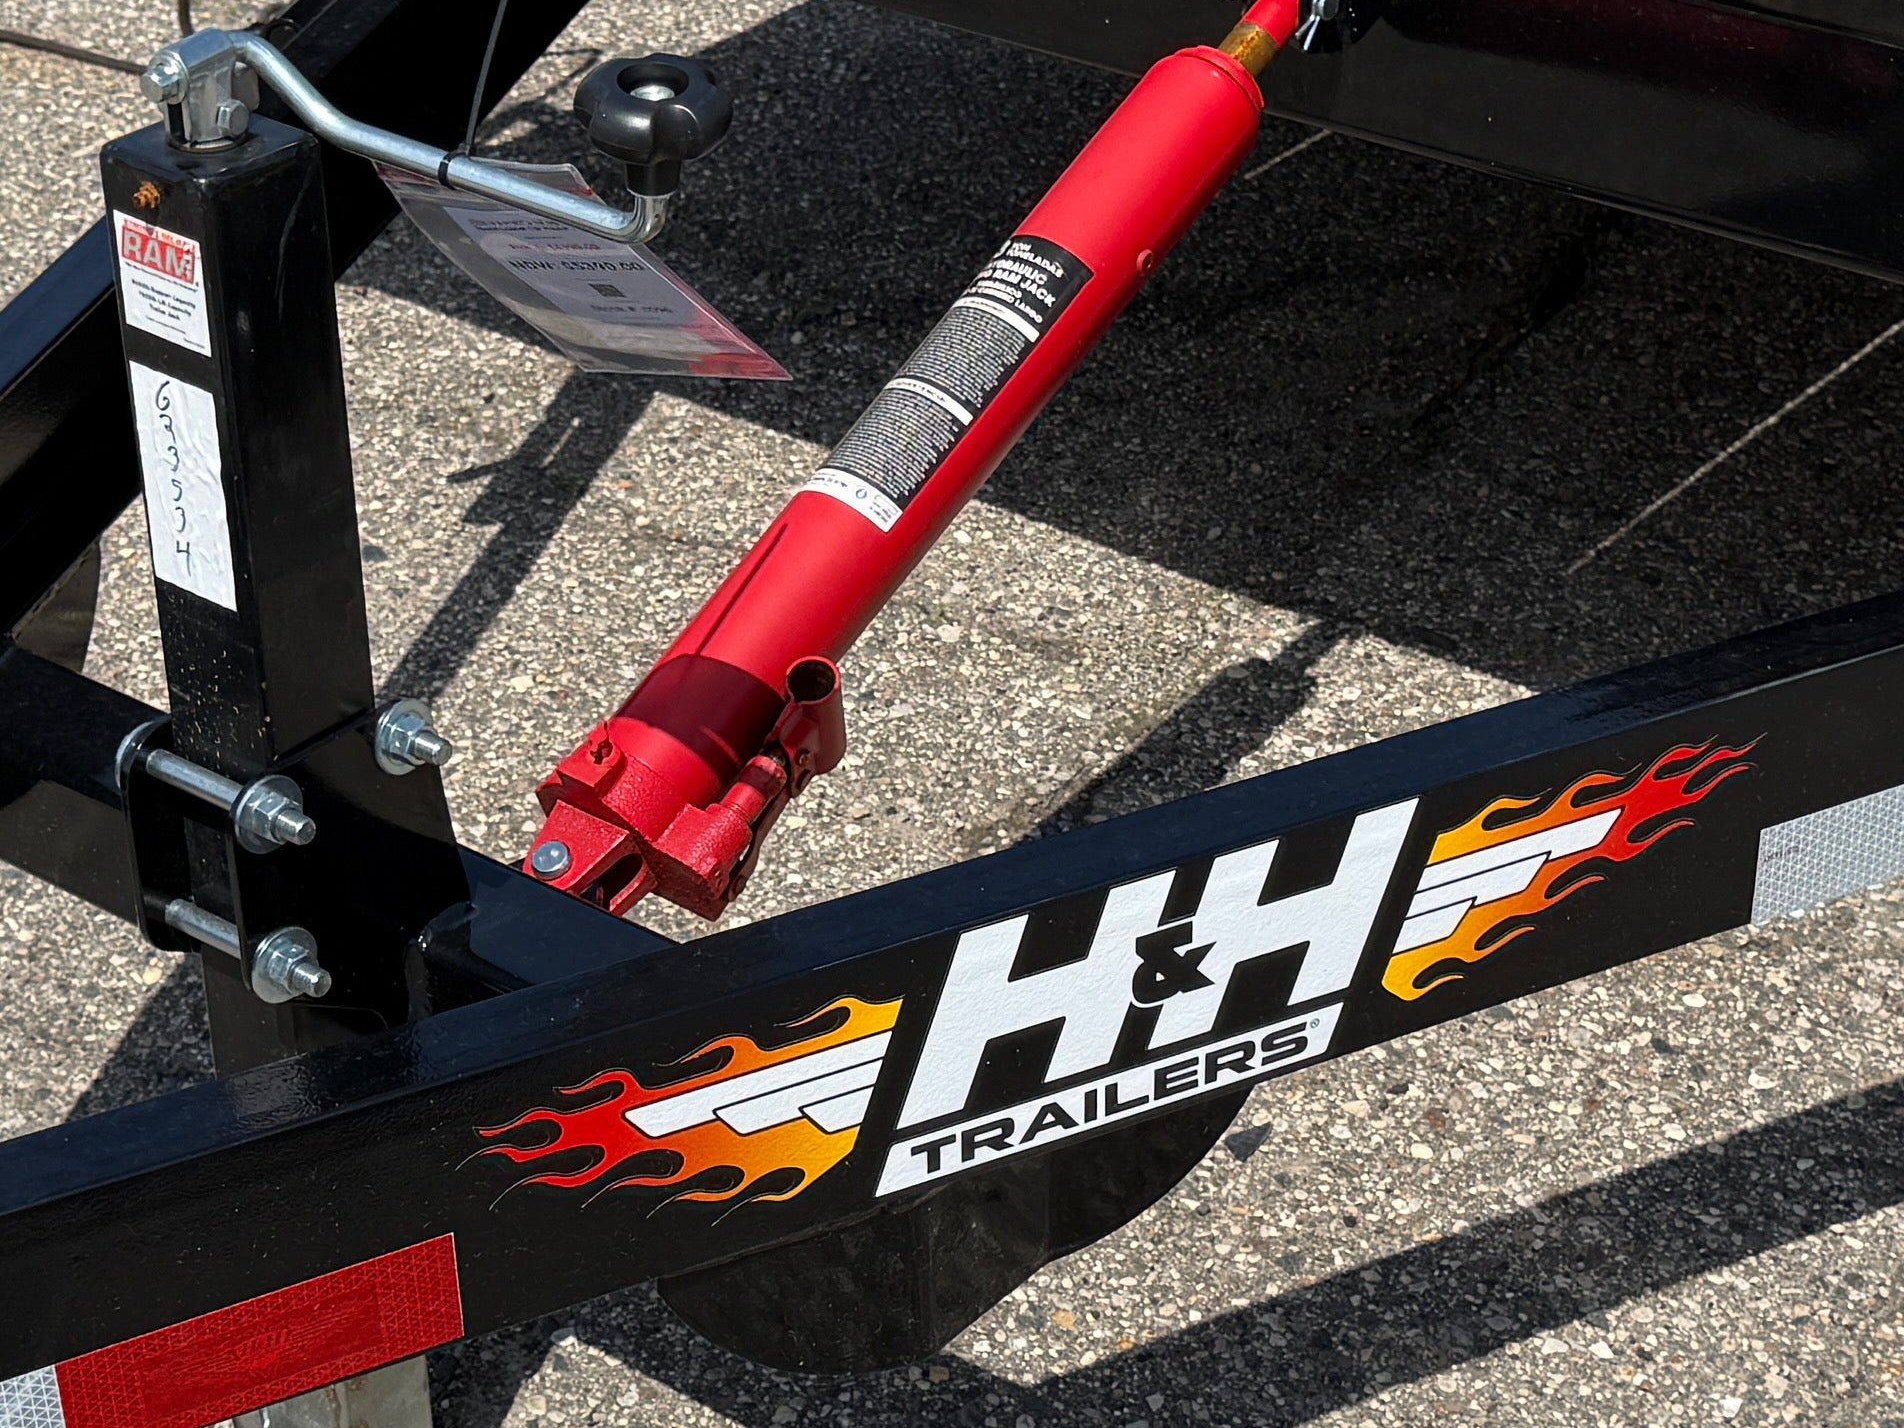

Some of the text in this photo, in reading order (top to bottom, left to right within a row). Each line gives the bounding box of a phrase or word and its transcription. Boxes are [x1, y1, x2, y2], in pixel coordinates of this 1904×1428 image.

[1020, 279, 1056, 308] JACK
[896, 798, 1419, 1130] H&H
[910, 1021, 1312, 1174] TRAILERS
